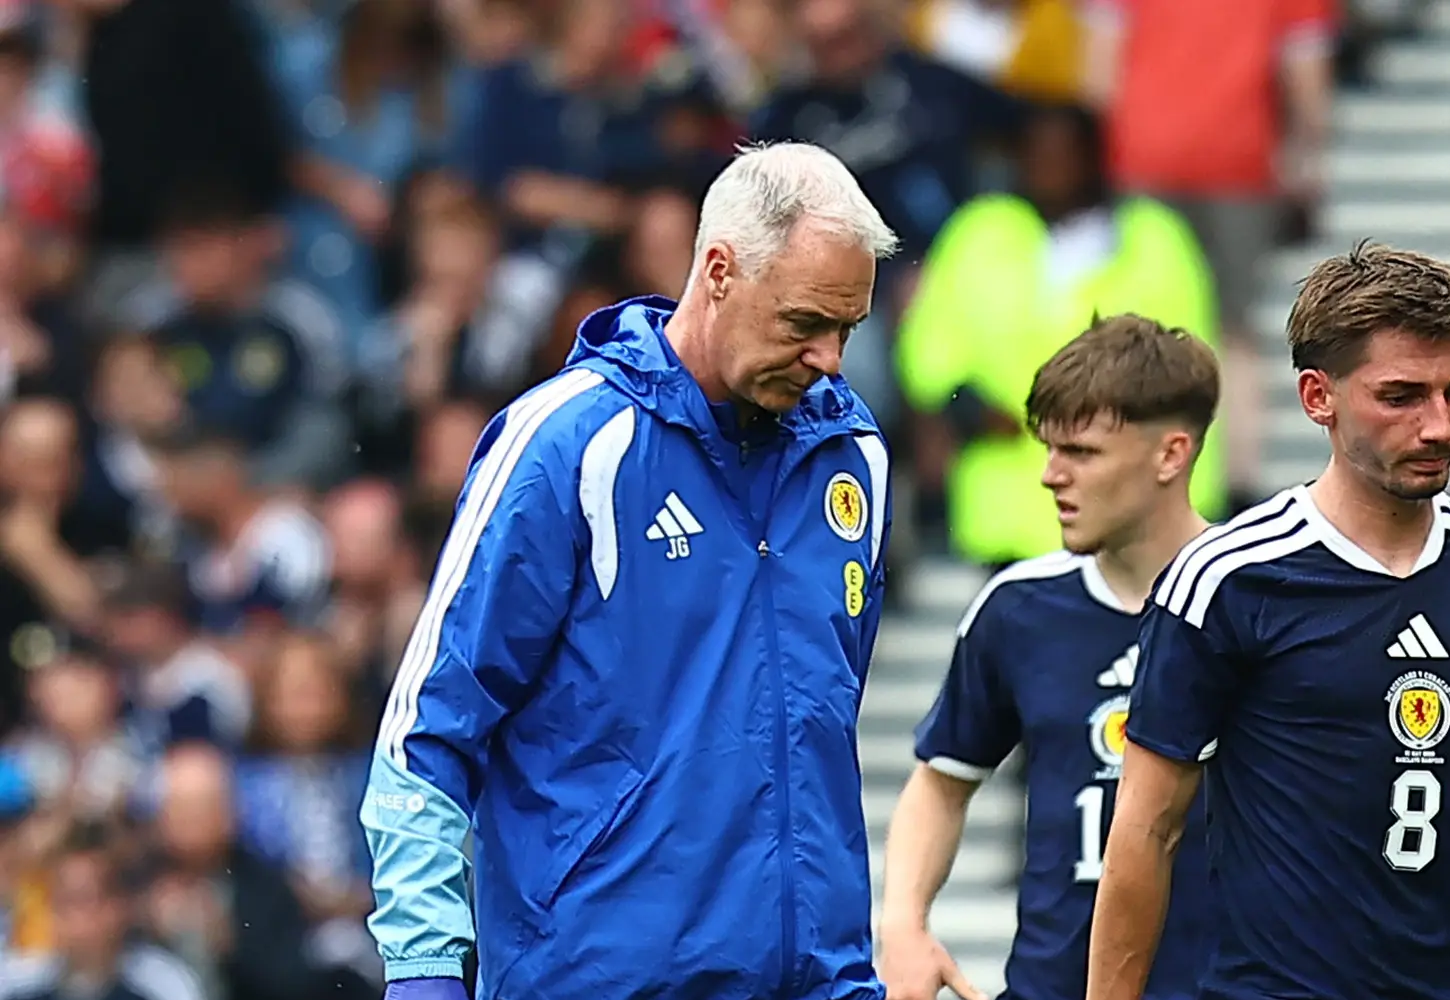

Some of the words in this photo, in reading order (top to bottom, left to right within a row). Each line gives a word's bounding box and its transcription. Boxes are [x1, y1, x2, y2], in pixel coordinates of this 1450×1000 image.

[666, 536, 690, 560] JG
[1075, 785, 1104, 882] 1
[1382, 769, 1441, 872] 8
